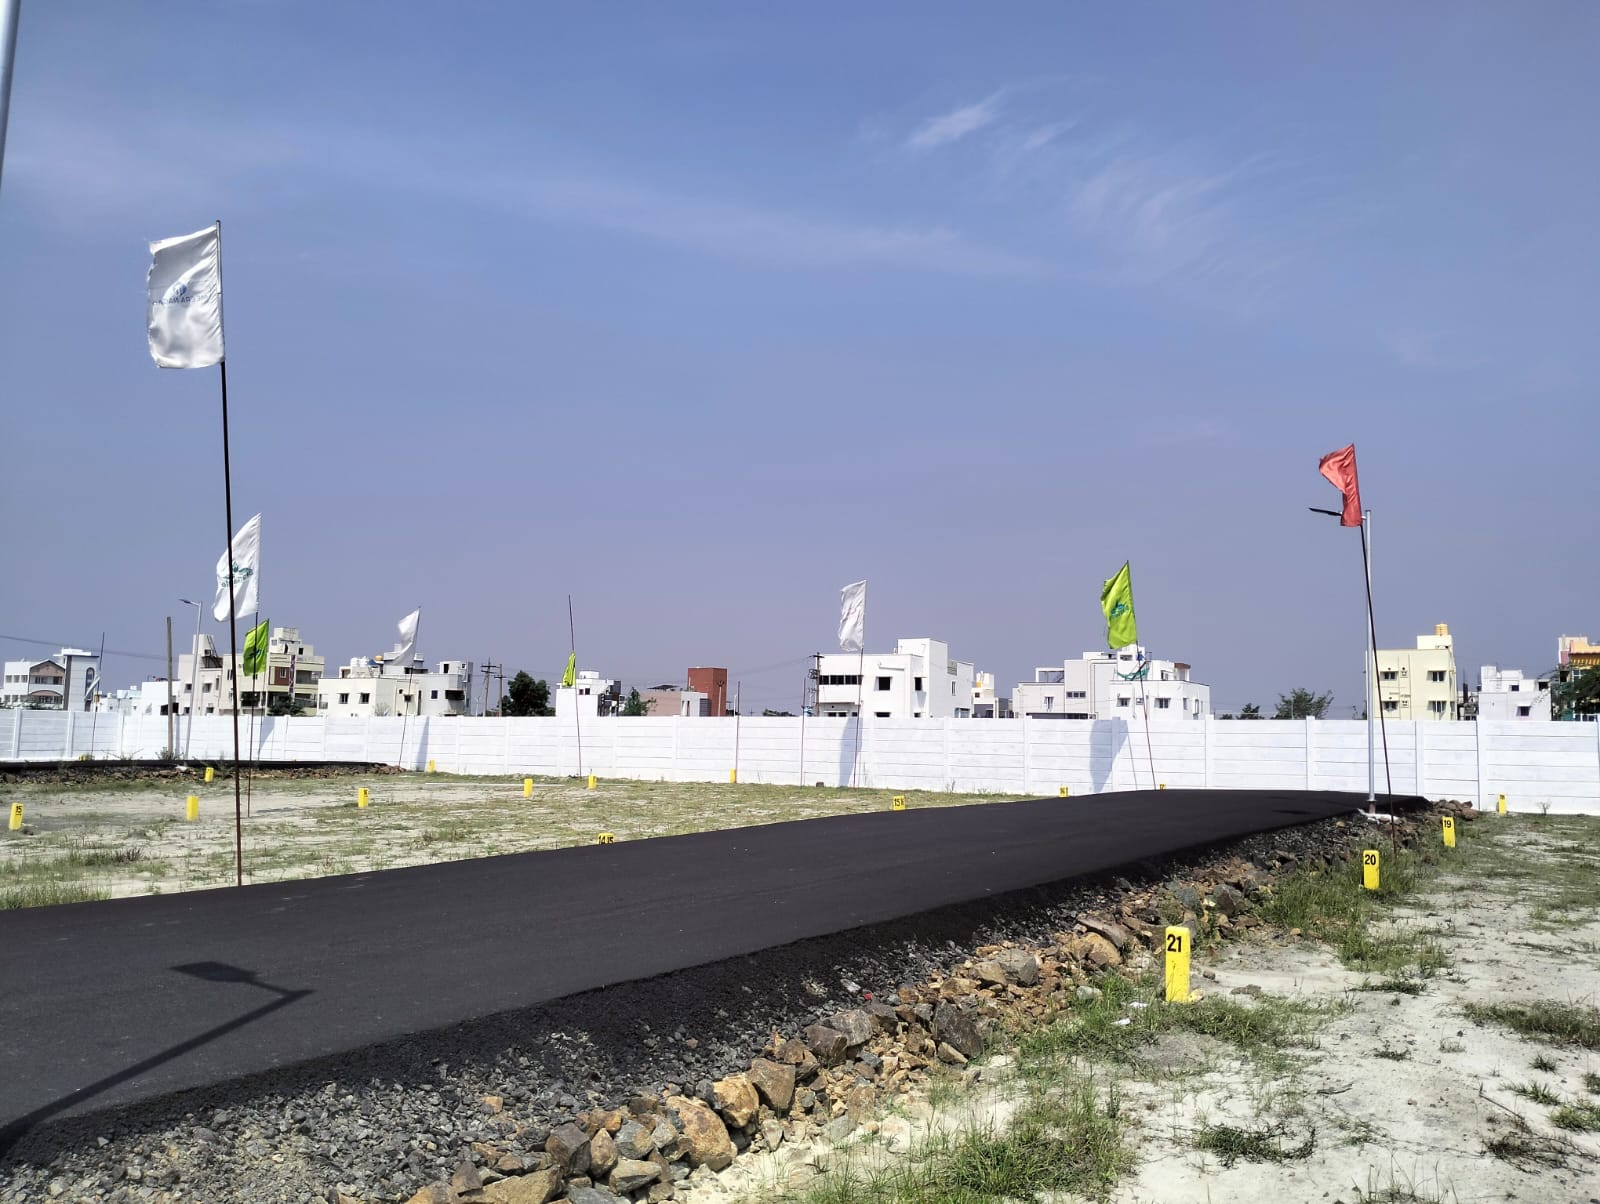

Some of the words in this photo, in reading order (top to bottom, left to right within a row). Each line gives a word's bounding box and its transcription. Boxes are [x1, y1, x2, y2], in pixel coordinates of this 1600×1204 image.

[1444, 819, 1452, 828] 19
[1365, 854, 1376, 865] 20
[1167, 933, 1182, 952] 21
